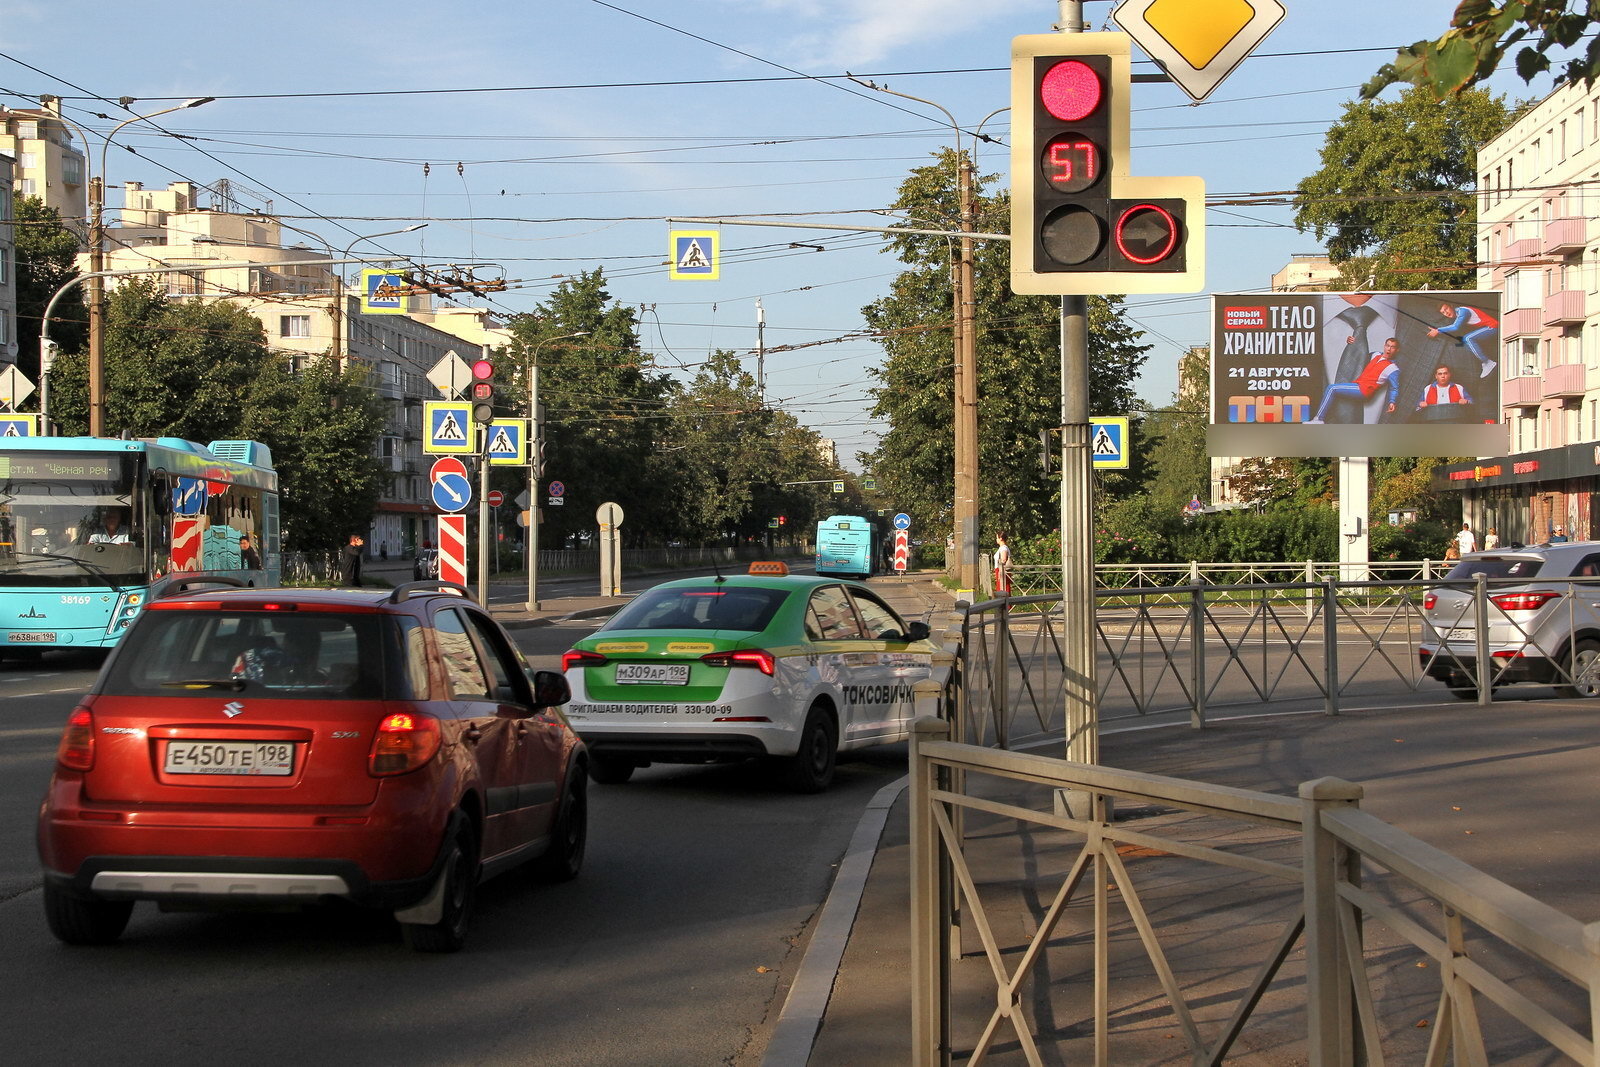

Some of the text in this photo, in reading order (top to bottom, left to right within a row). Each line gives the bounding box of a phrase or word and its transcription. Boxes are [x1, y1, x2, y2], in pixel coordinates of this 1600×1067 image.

[1050, 142, 1095, 182] 57
[1227, 318, 1263, 326] СЕРИАЛ
[1270, 305, 1316, 329] ТЕЛО
[1223, 331, 1316, 355] ХРАНИТЕЛИ
[1228, 367, 1310, 378] 21 АВГУСТА
[476, 384, 491, 397] 57
[1247, 379, 1292, 391] 20:00
[1228, 395, 1310, 423] ТНТ
[60, 595, 91, 605] 38169
[619, 666, 687, 679] М309АР 198
[842, 685, 915, 705] таксовичк
[568, 703, 732, 715] ПРИГЛАШАЕМ ВОДИТЕЛЕЙ 330-00-09
[172, 745, 288, 766] Е450ТЕ 198
